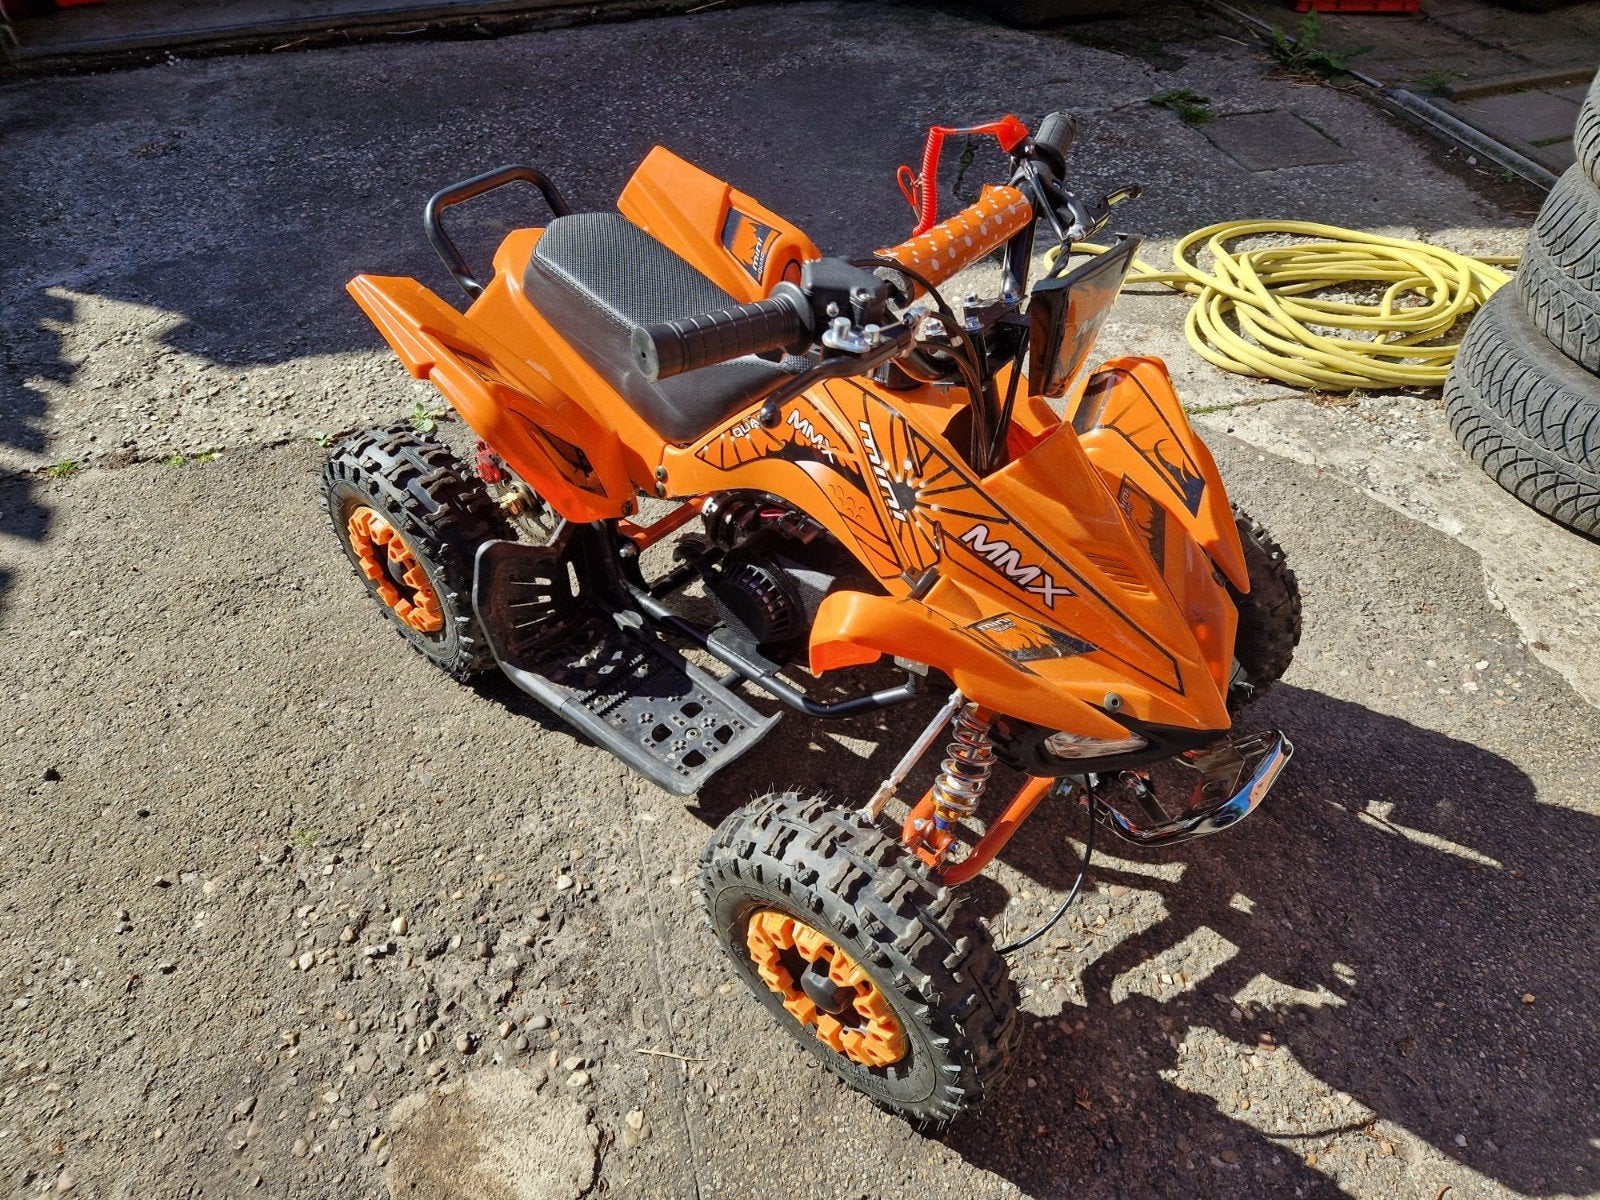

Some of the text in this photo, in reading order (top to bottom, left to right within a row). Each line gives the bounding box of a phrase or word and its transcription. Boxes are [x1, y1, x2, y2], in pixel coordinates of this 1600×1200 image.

[731, 414, 761, 438] QUA
[786, 409, 834, 464] MMX
[859, 420, 907, 522] mini
[959, 524, 1076, 609] MMX
